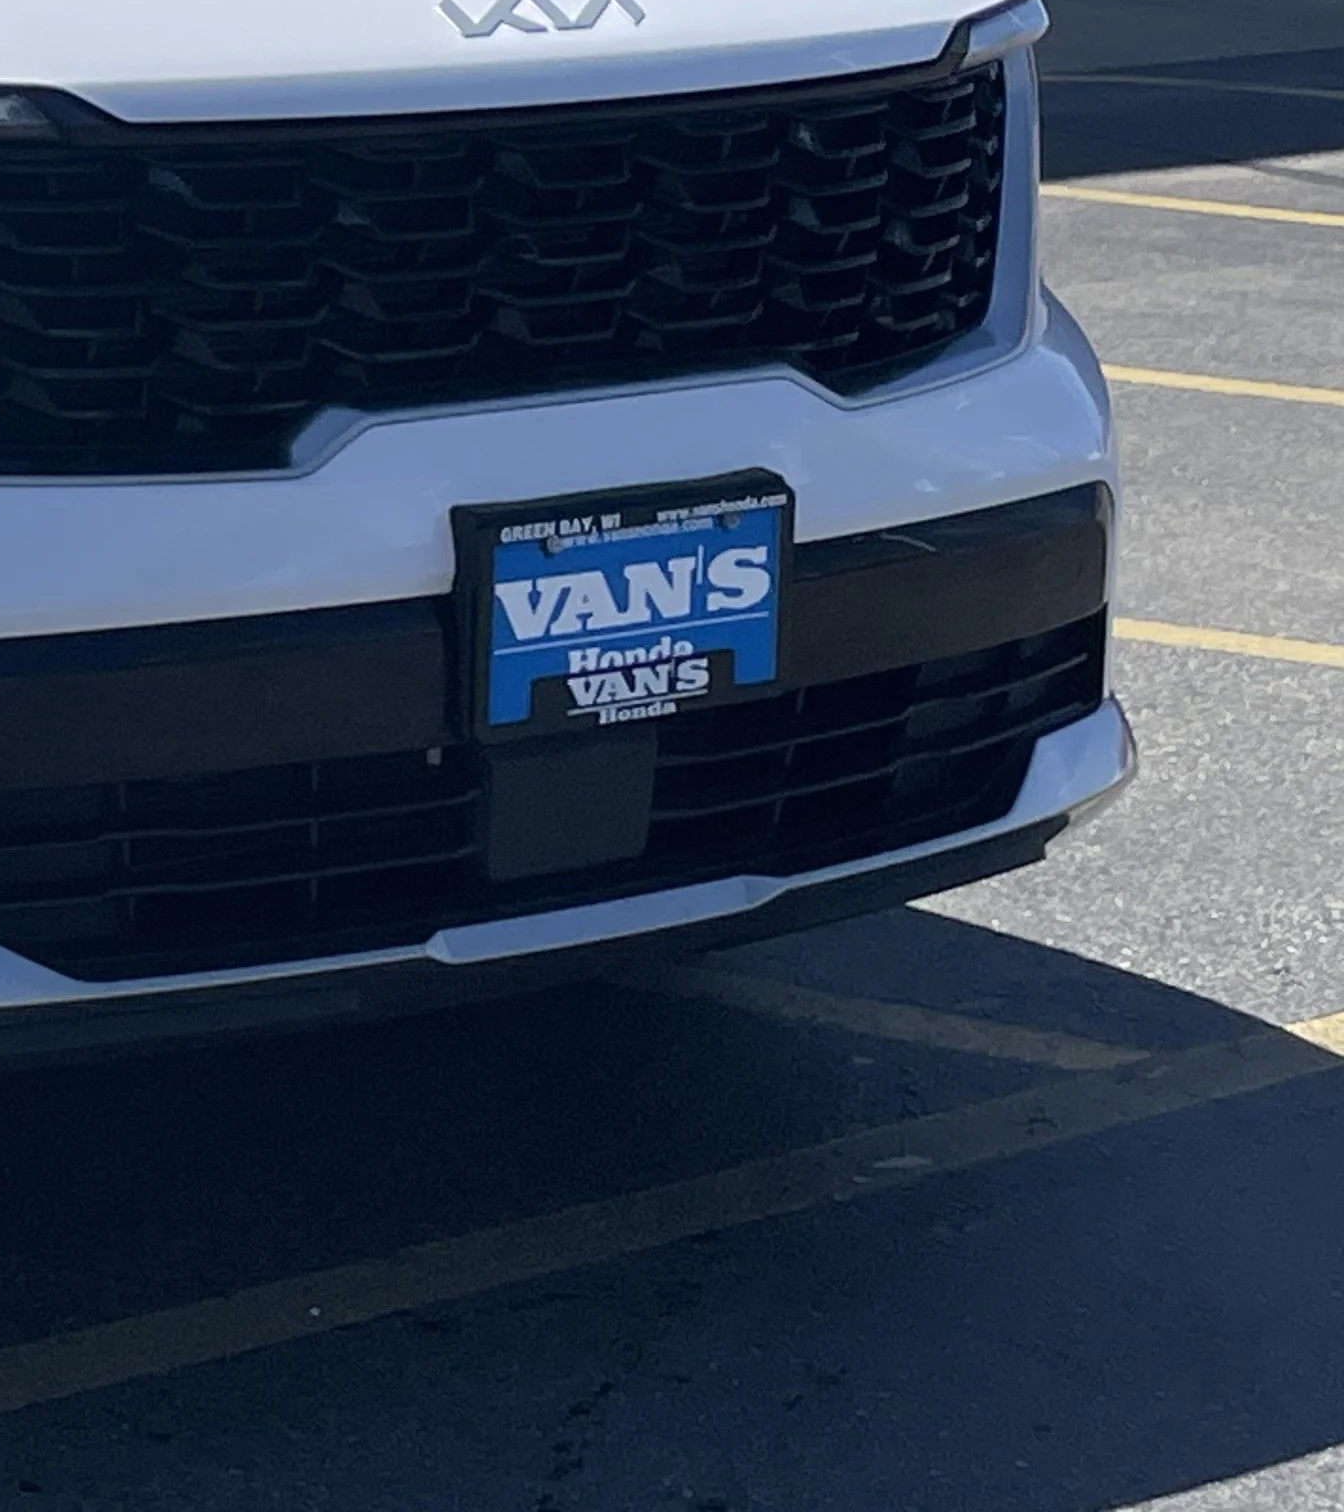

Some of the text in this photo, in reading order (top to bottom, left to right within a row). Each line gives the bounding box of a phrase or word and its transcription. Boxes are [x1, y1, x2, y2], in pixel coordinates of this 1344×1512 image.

[500, 521, 556, 543] GREEN
[600, 513, 621, 529] WI
[494, 545, 771, 641] VAN'S
[567, 636, 694, 674] Honda
[567, 657, 710, 706] VAN'S
[599, 702, 678, 725] Honda
